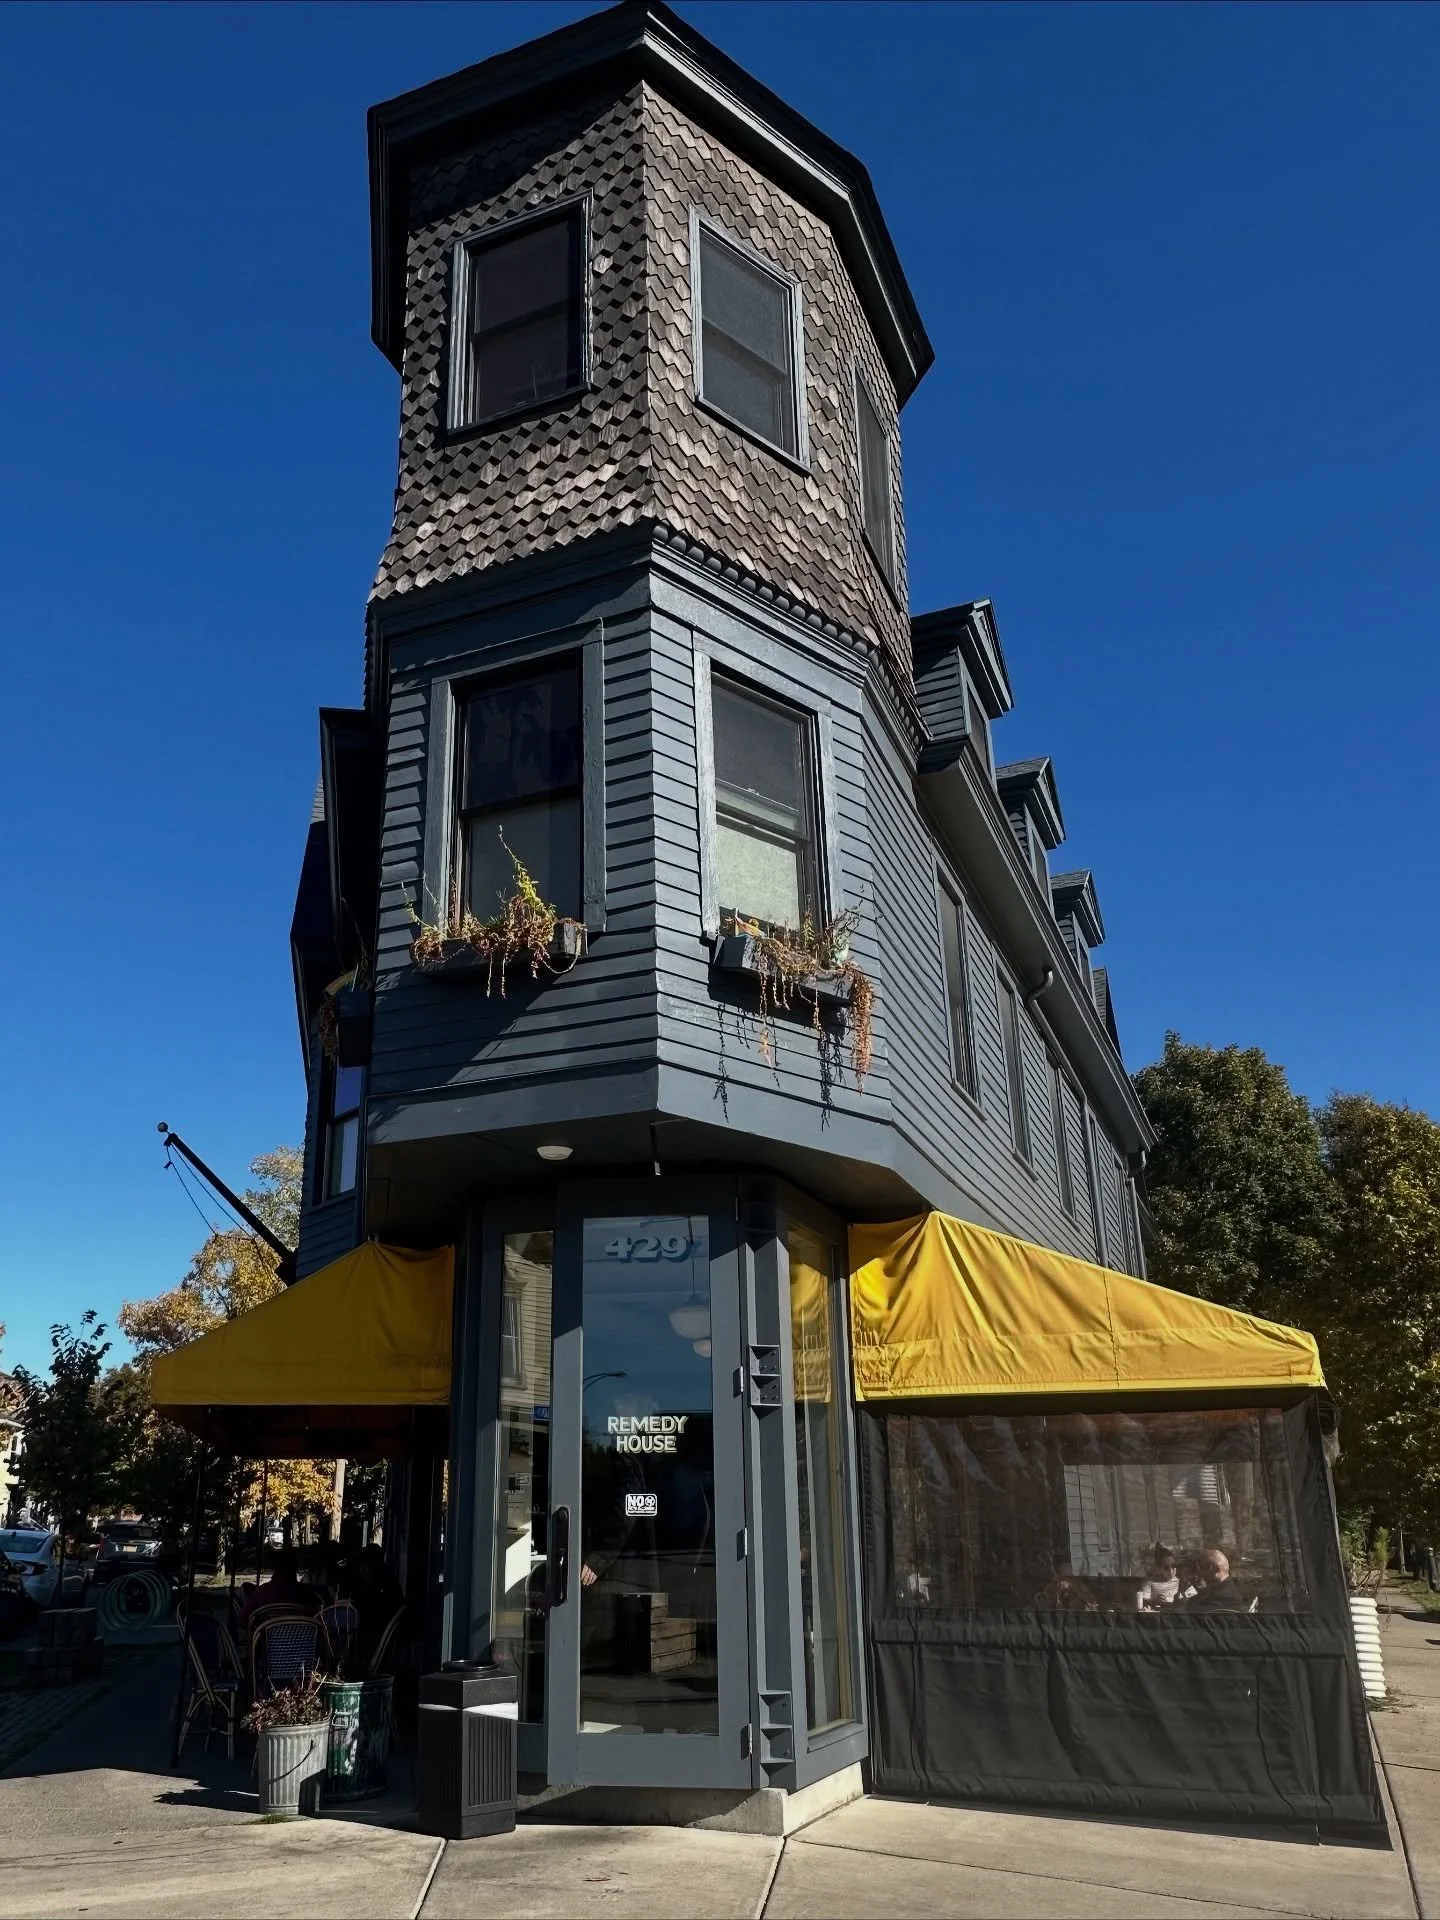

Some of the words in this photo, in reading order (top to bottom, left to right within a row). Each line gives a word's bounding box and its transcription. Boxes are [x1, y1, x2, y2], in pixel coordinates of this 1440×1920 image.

[604, 1235, 691, 1263] 429
[607, 1415, 688, 1434] REMEDY
[616, 1435, 677, 1453] HOUSE
